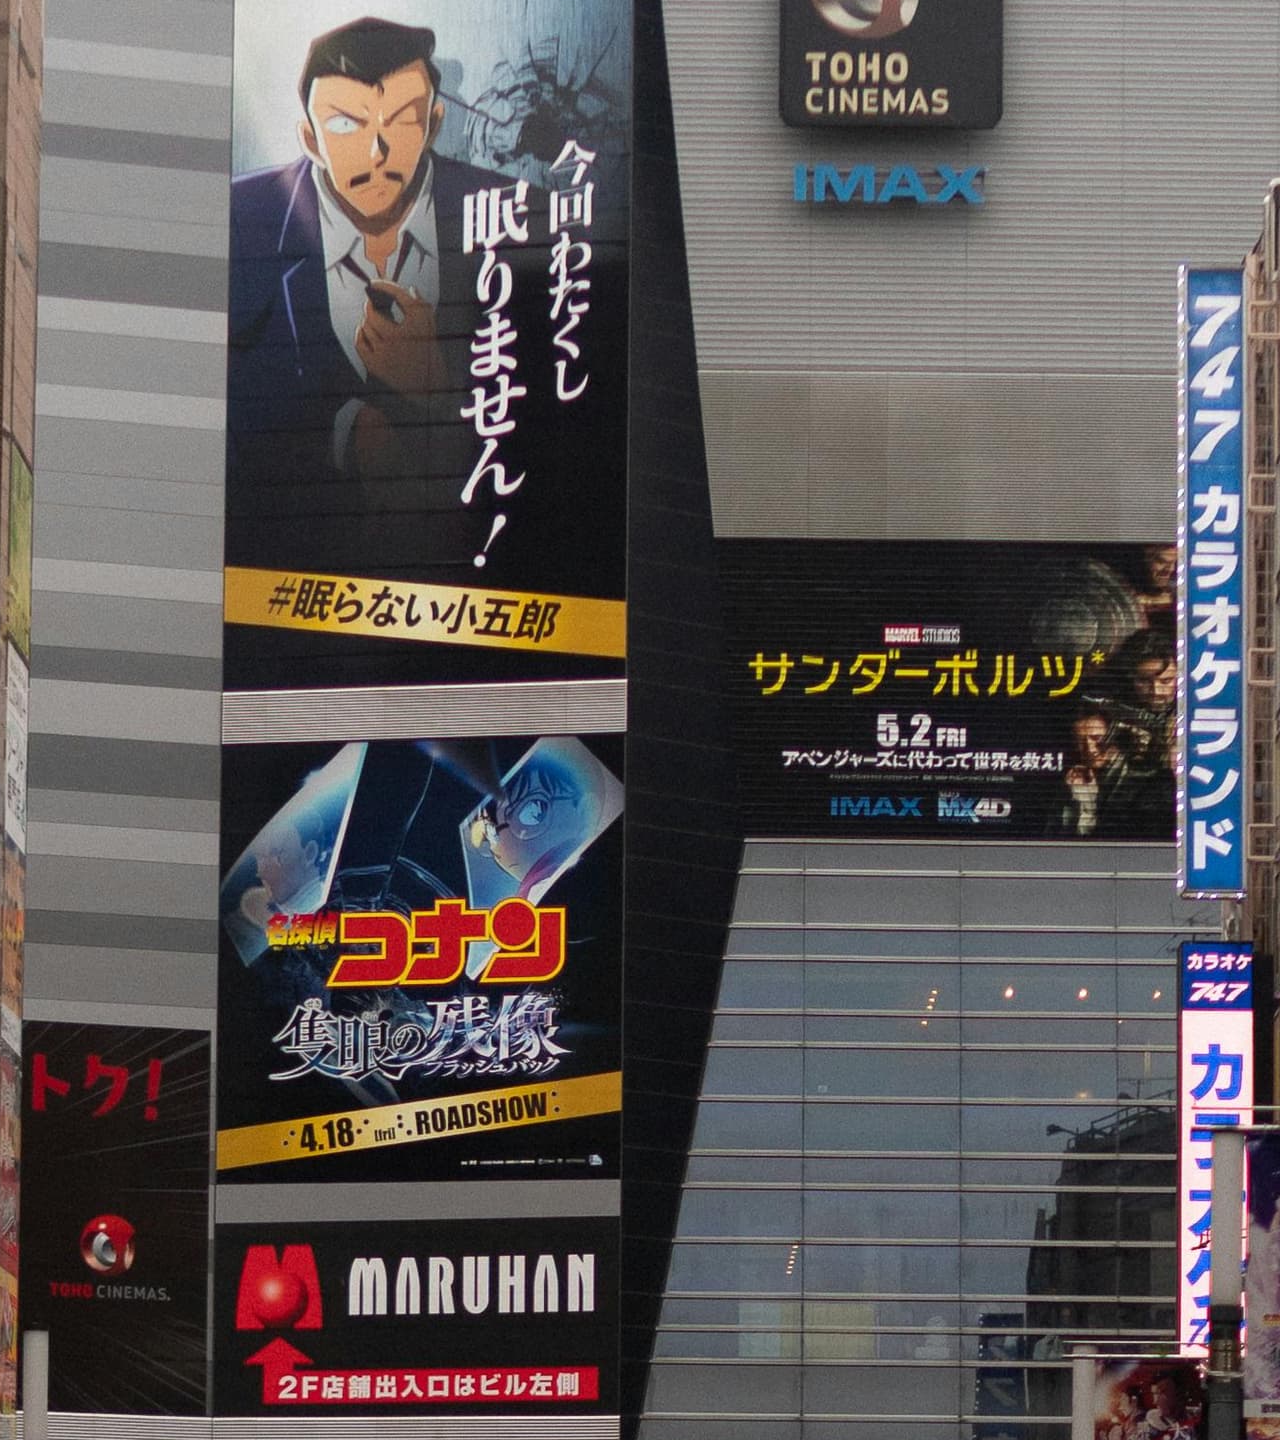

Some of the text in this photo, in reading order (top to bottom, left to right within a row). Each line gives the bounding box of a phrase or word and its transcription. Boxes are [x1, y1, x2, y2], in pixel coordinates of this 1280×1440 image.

[806, 52, 908, 83] TOHO
[805, 88, 950, 115] CINEMAS
[793, 165, 985, 205] IMAX
[548, 139, 596, 401] 今回わたくし
[459, 178, 529, 568] 眠りません!
[1189, 295, 1242, 871] 747 カラオケランド
[266, 577, 562, 645] #眠らない小五郎
[876, 713, 967, 748] 5.2 FRI
[829, 795, 1012, 822] IMAX MX4D
[265, 896, 568, 988] 名探偵 コナン
[1186, 952, 1252, 972] カラオケ
[1187, 982, 1250, 1003] 747
[422, 1054, 561, 1078] フラッシュバック
[414, 1093, 549, 1138] ROADSHOW
[299, 1120, 355, 1153] 4.18
[49, 1282, 93, 1297] TOHO
[348, 1252, 596, 1317] MARUHAN
[277, 1368, 582, 1401] 2F店舗出入口はビル左側
